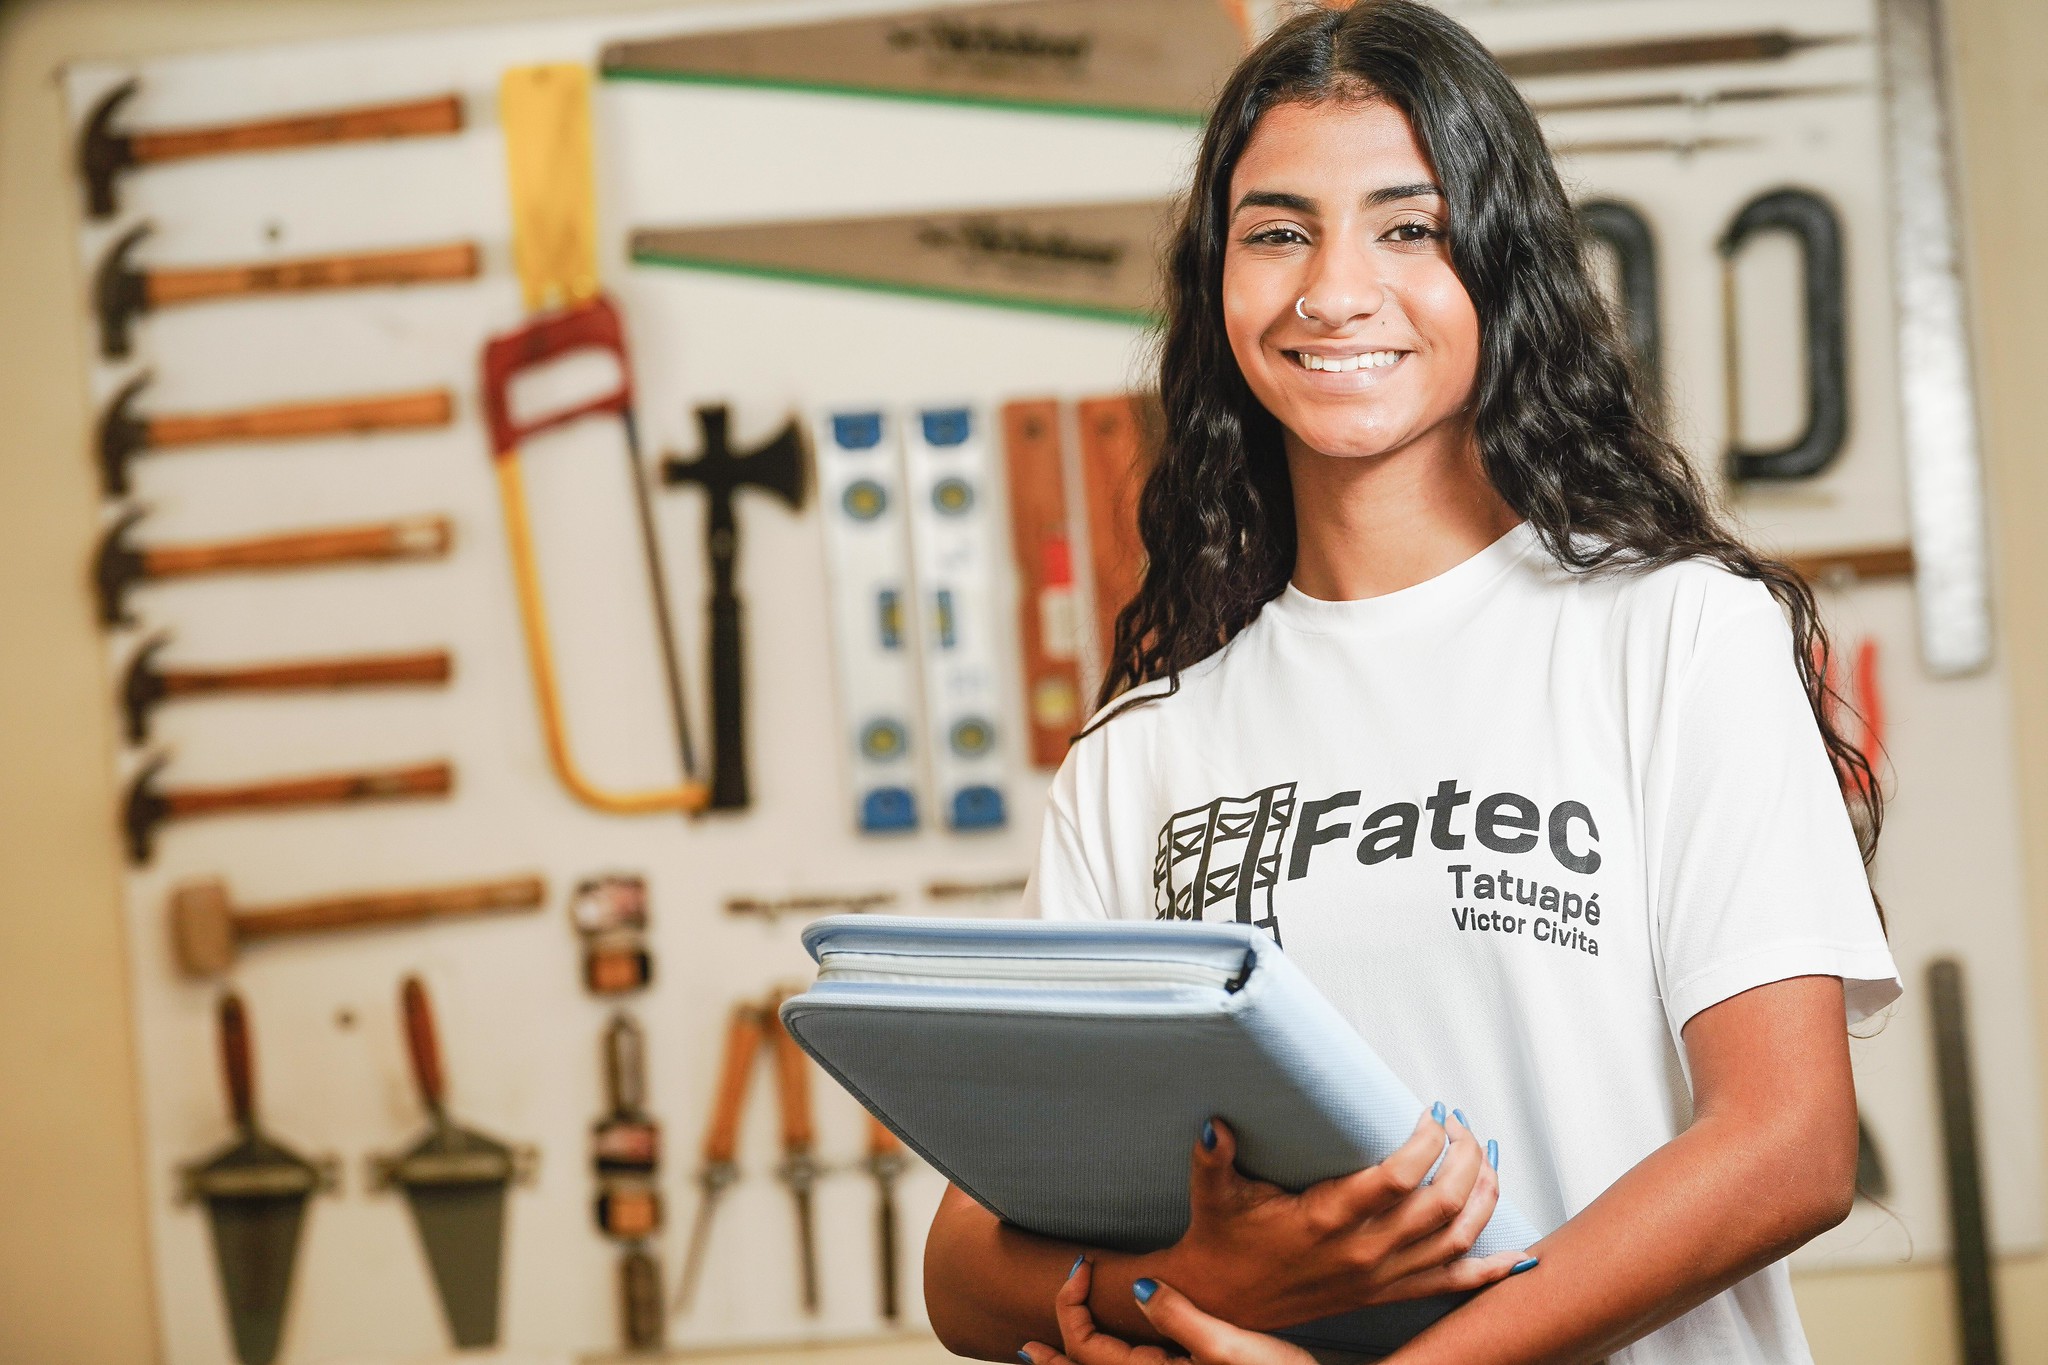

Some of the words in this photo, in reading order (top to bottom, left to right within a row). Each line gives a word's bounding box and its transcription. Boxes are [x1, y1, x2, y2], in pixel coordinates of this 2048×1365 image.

[1287, 779, 1601, 881] Fatec
[1447, 864, 1601, 926] Tatuapé
[1451, 907, 1527, 935] Victor
[1533, 917, 1599, 957] Civita
